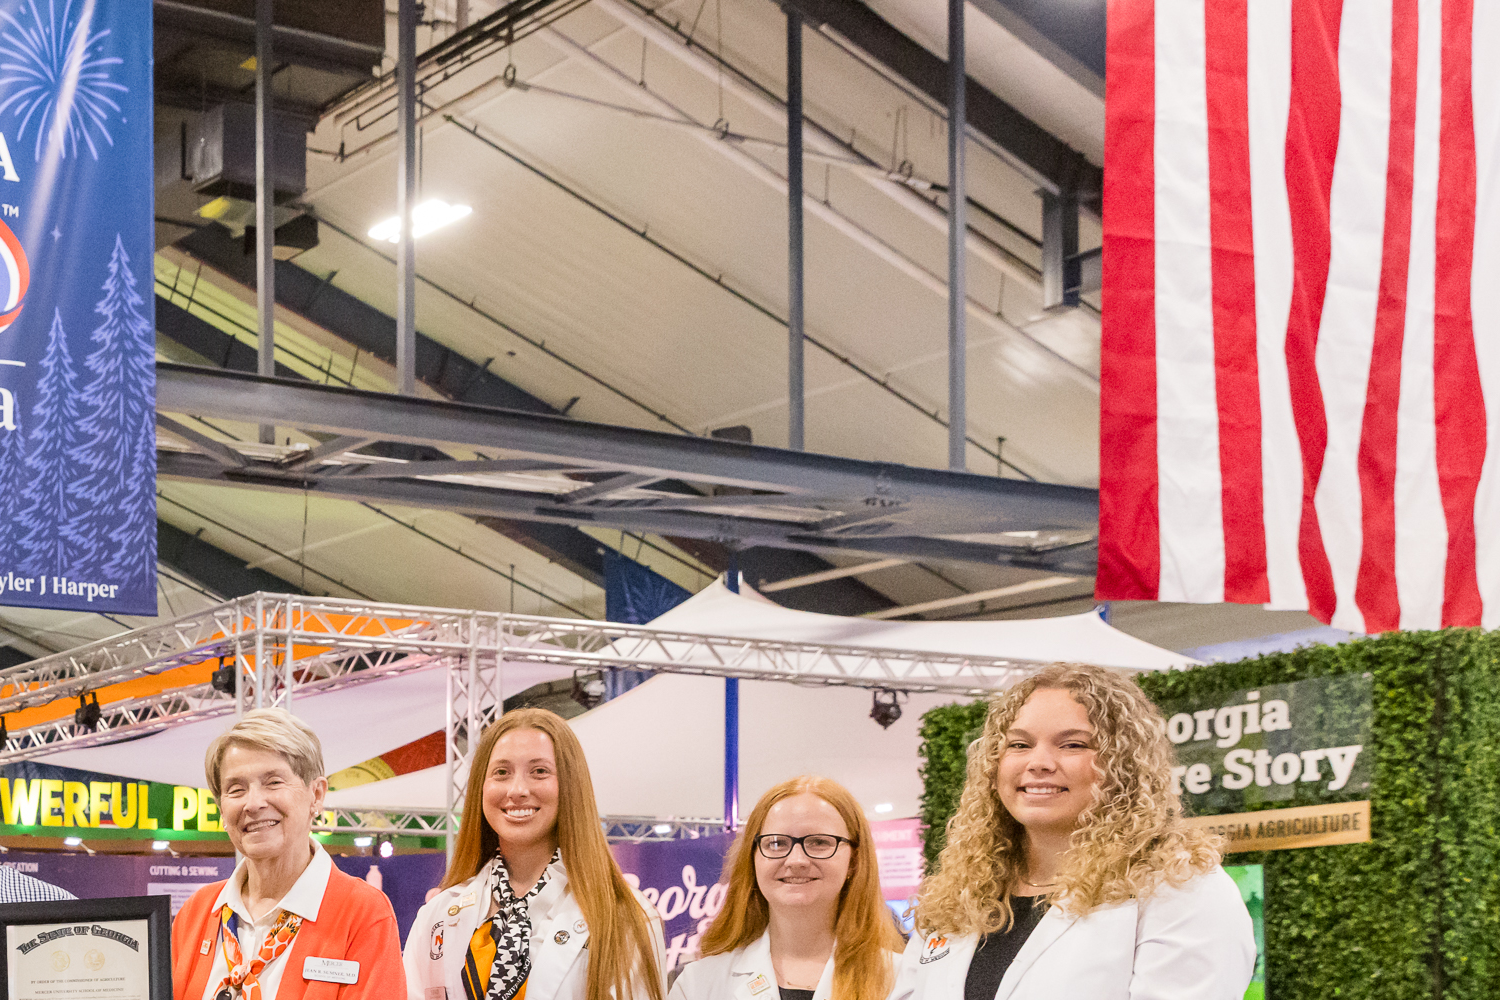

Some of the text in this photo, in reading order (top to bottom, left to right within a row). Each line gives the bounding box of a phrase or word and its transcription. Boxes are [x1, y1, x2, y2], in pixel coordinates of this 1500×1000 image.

[38, 574, 47, 596] J
[52, 576, 119, 602] Harper
[1222, 744, 1363, 791] Story
[1256, 812, 1362, 839] AGRICULTURE
[189, 866, 218, 876] SEWING
